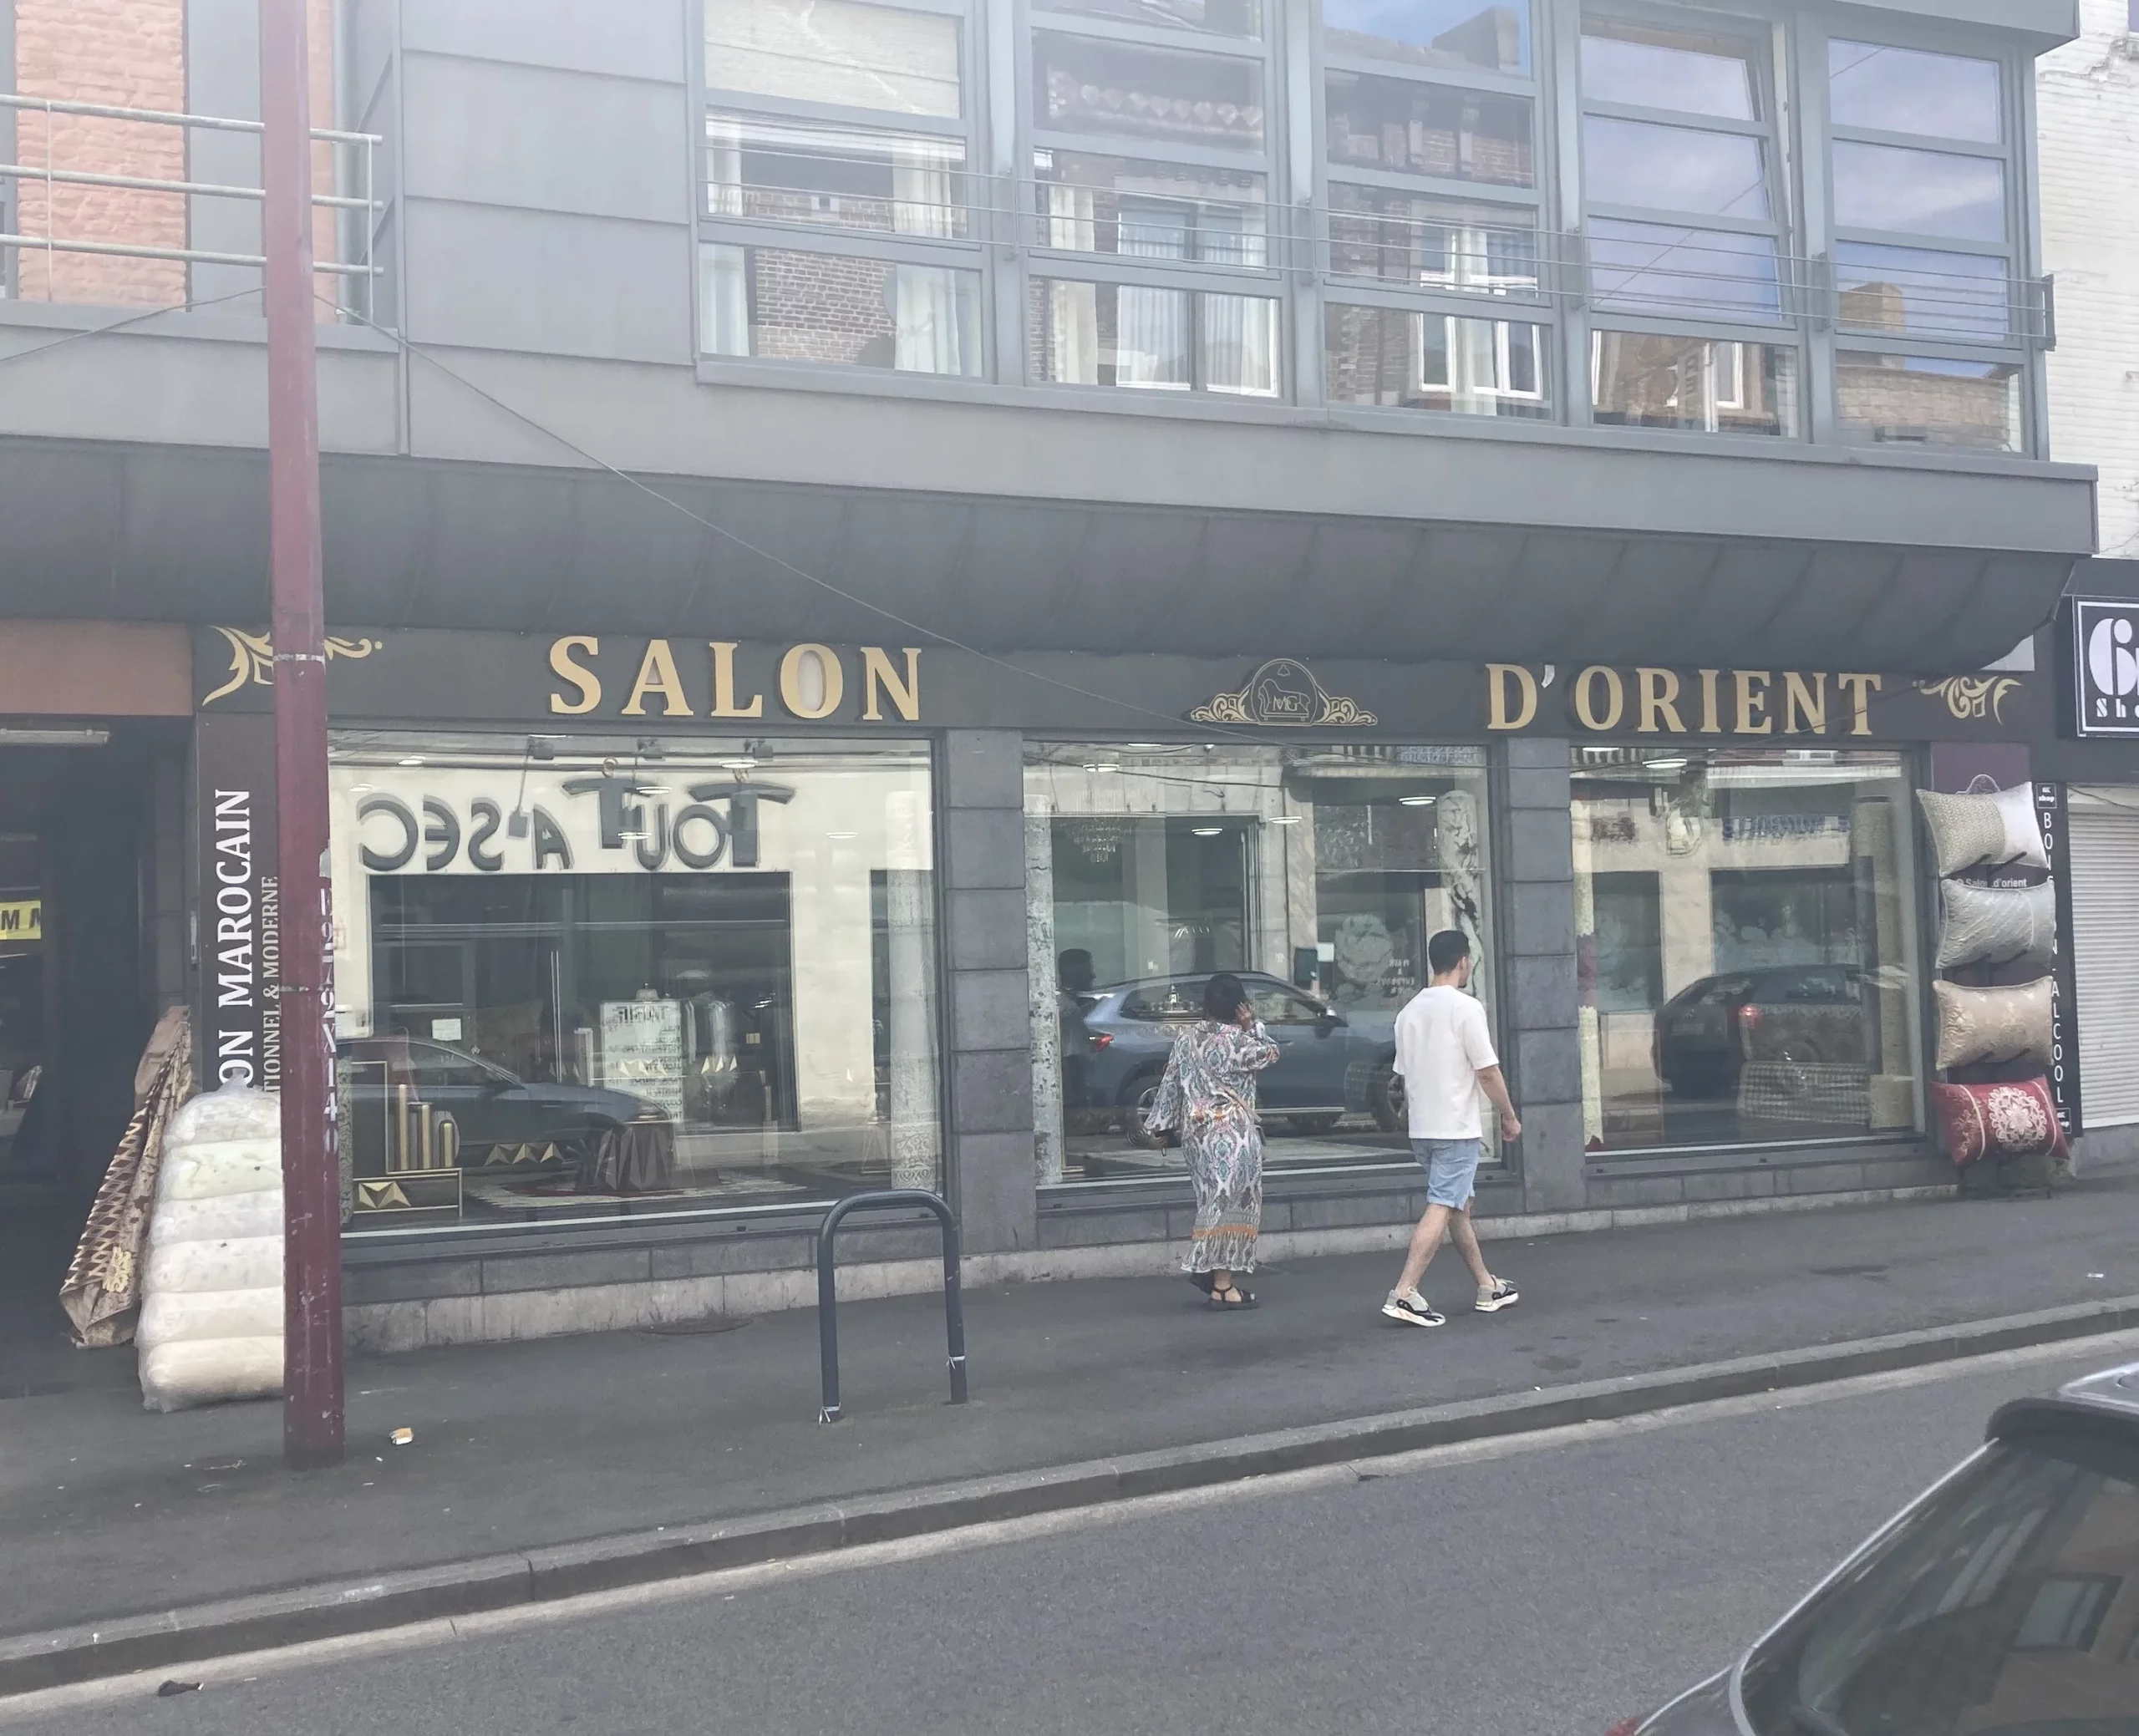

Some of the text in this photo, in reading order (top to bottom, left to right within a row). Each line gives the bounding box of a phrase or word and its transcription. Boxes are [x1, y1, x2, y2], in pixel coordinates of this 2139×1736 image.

[549, 636, 1882, 736] SALON D'ORIENT
[2089, 618, 2139, 696] 6
[215, 789, 253, 1008] MAROCAIN
[262, 876, 279, 978] MODERNE
[1965, 878, 2027, 887] Salo d'orient
[262, 984, 280, 999] &
